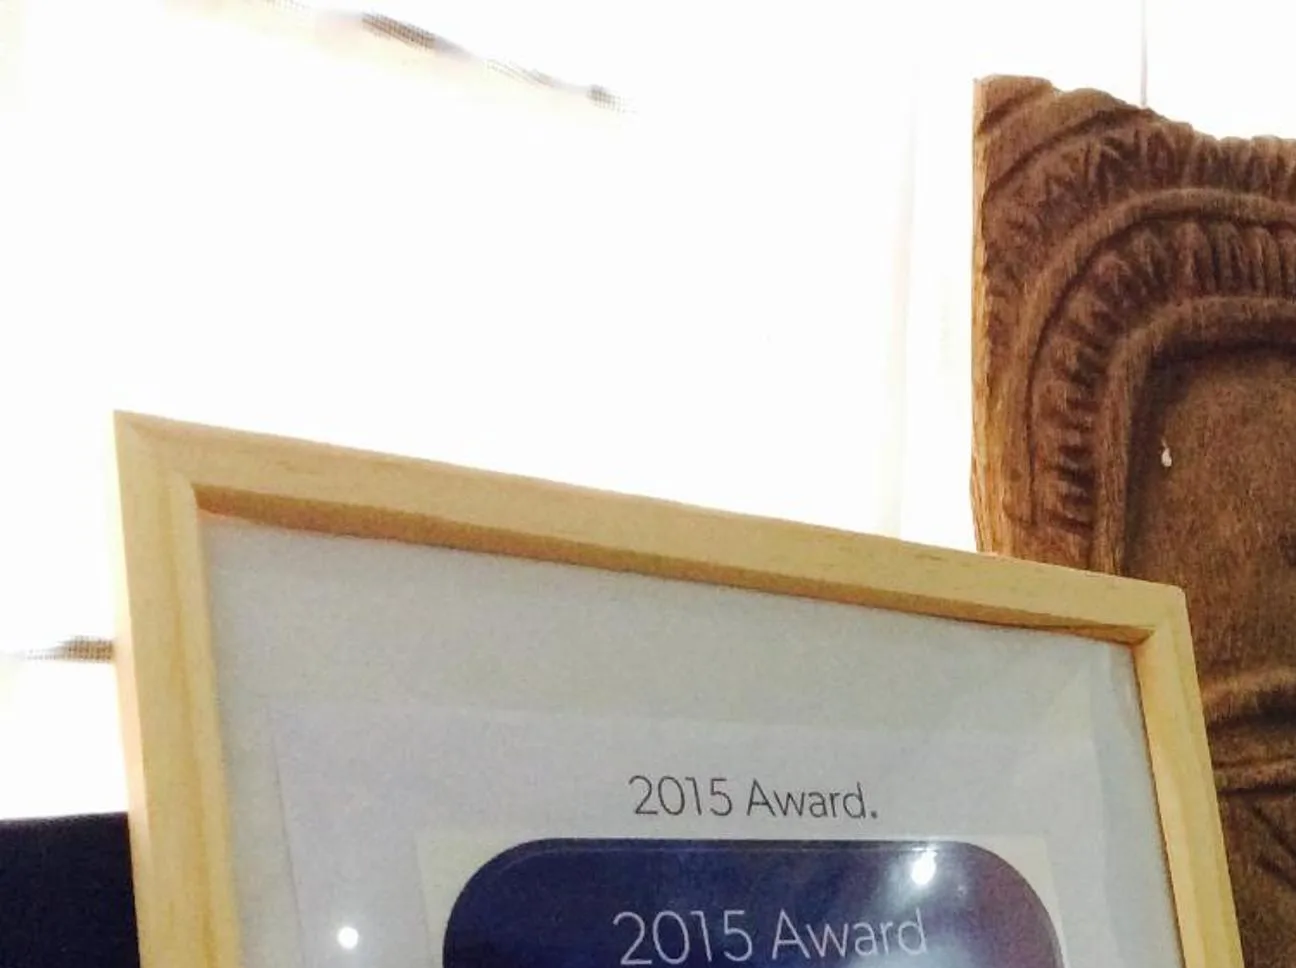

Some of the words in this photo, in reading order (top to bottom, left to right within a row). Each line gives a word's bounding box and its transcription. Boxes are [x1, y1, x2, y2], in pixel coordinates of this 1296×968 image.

[628, 775, 733, 817] 2015
[746, 778, 878, 819] Award.
[612, 910, 753, 966] 2015
[771, 907, 928, 960] Award
